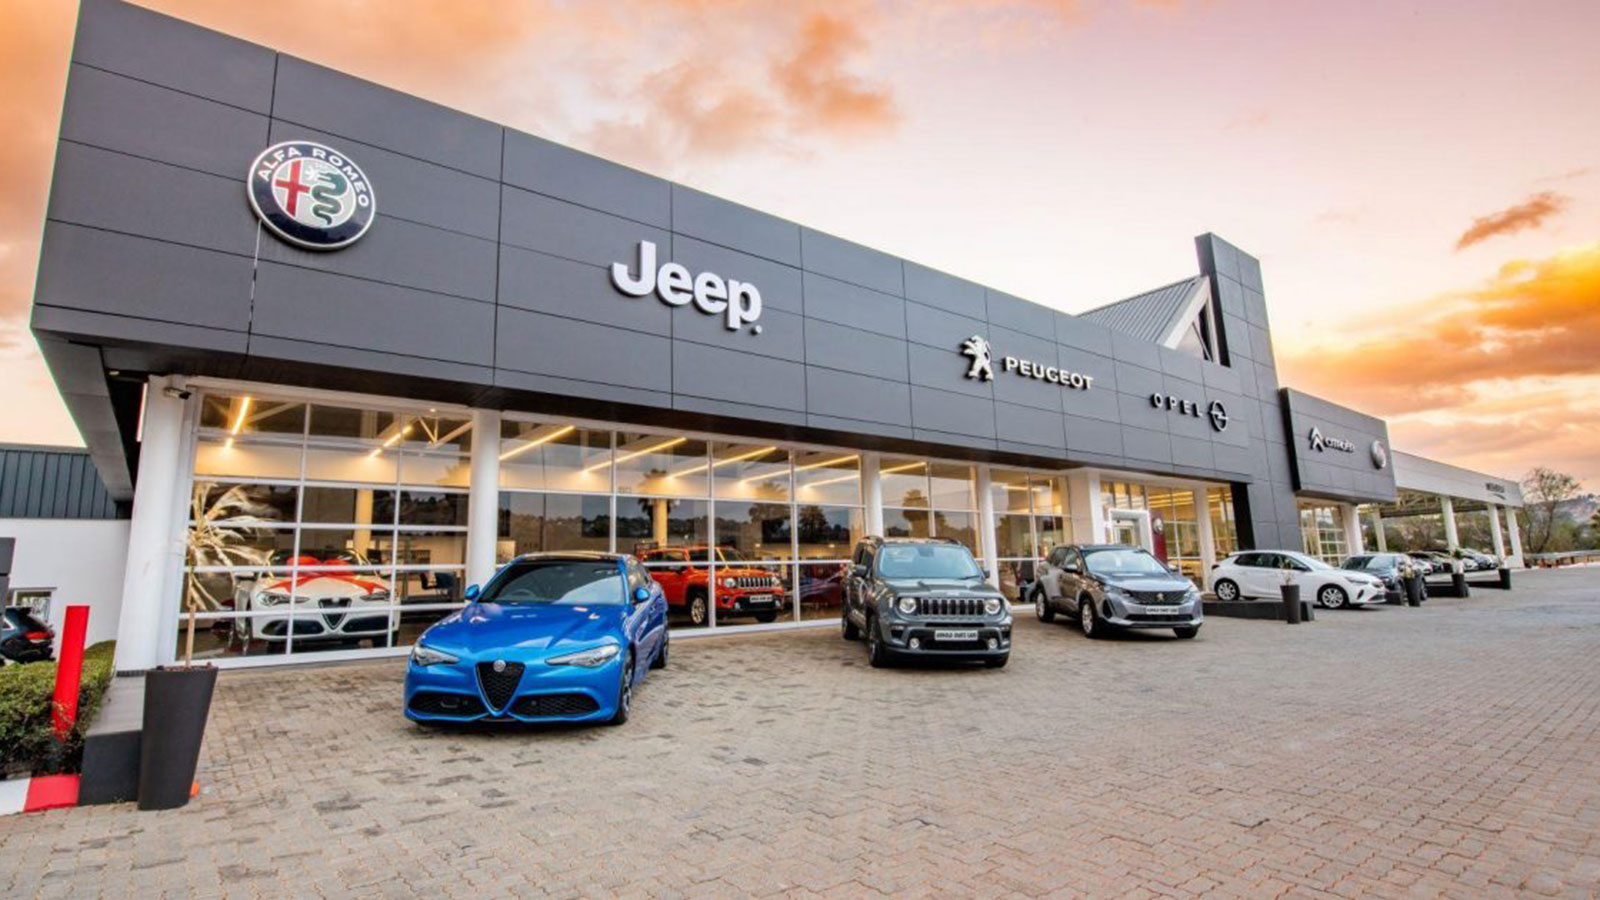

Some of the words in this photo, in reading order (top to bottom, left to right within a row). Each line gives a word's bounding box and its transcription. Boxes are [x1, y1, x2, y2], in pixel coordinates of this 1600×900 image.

[258, 147, 302, 182] ALFA
[312, 147, 369, 207] ROMEO
[611, 240, 762, 331] Jeep
[1003, 356, 1093, 389] PEUGEOT
[1152, 392, 1203, 417] OPEL
